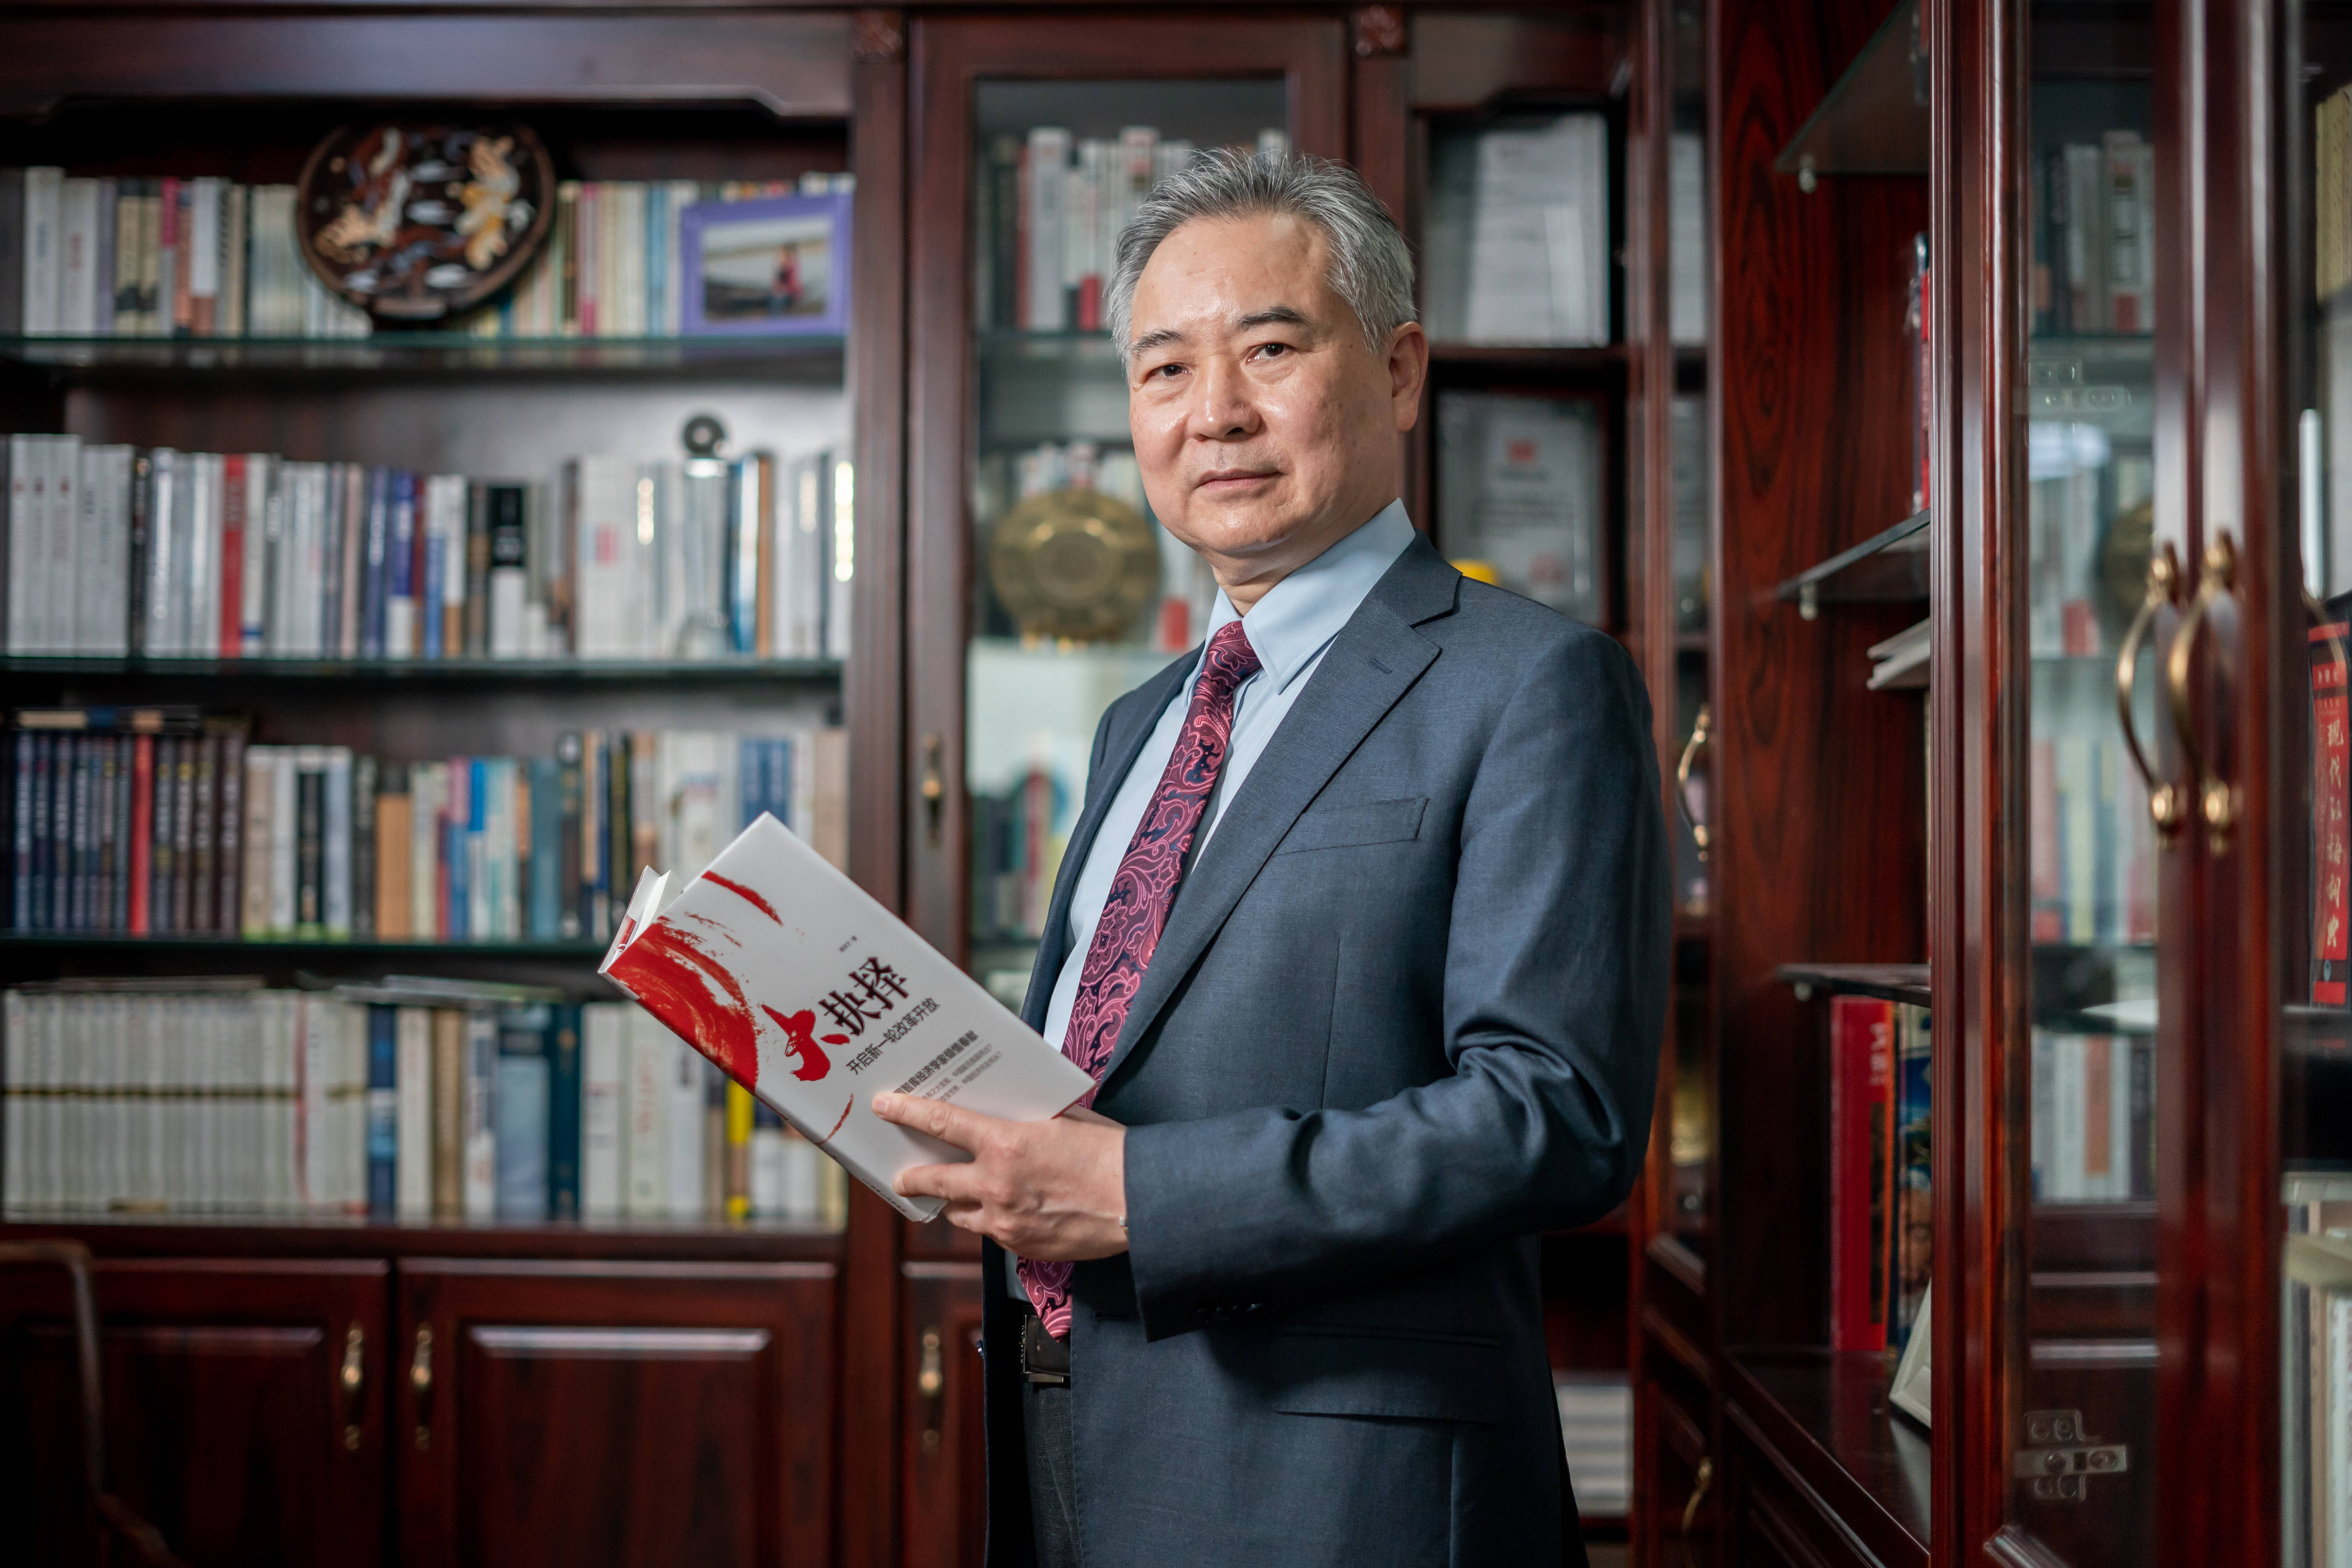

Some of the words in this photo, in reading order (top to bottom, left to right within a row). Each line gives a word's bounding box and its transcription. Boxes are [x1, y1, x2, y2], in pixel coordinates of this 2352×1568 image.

[846, 996, 940, 1075] 开启新一轮改革开放
